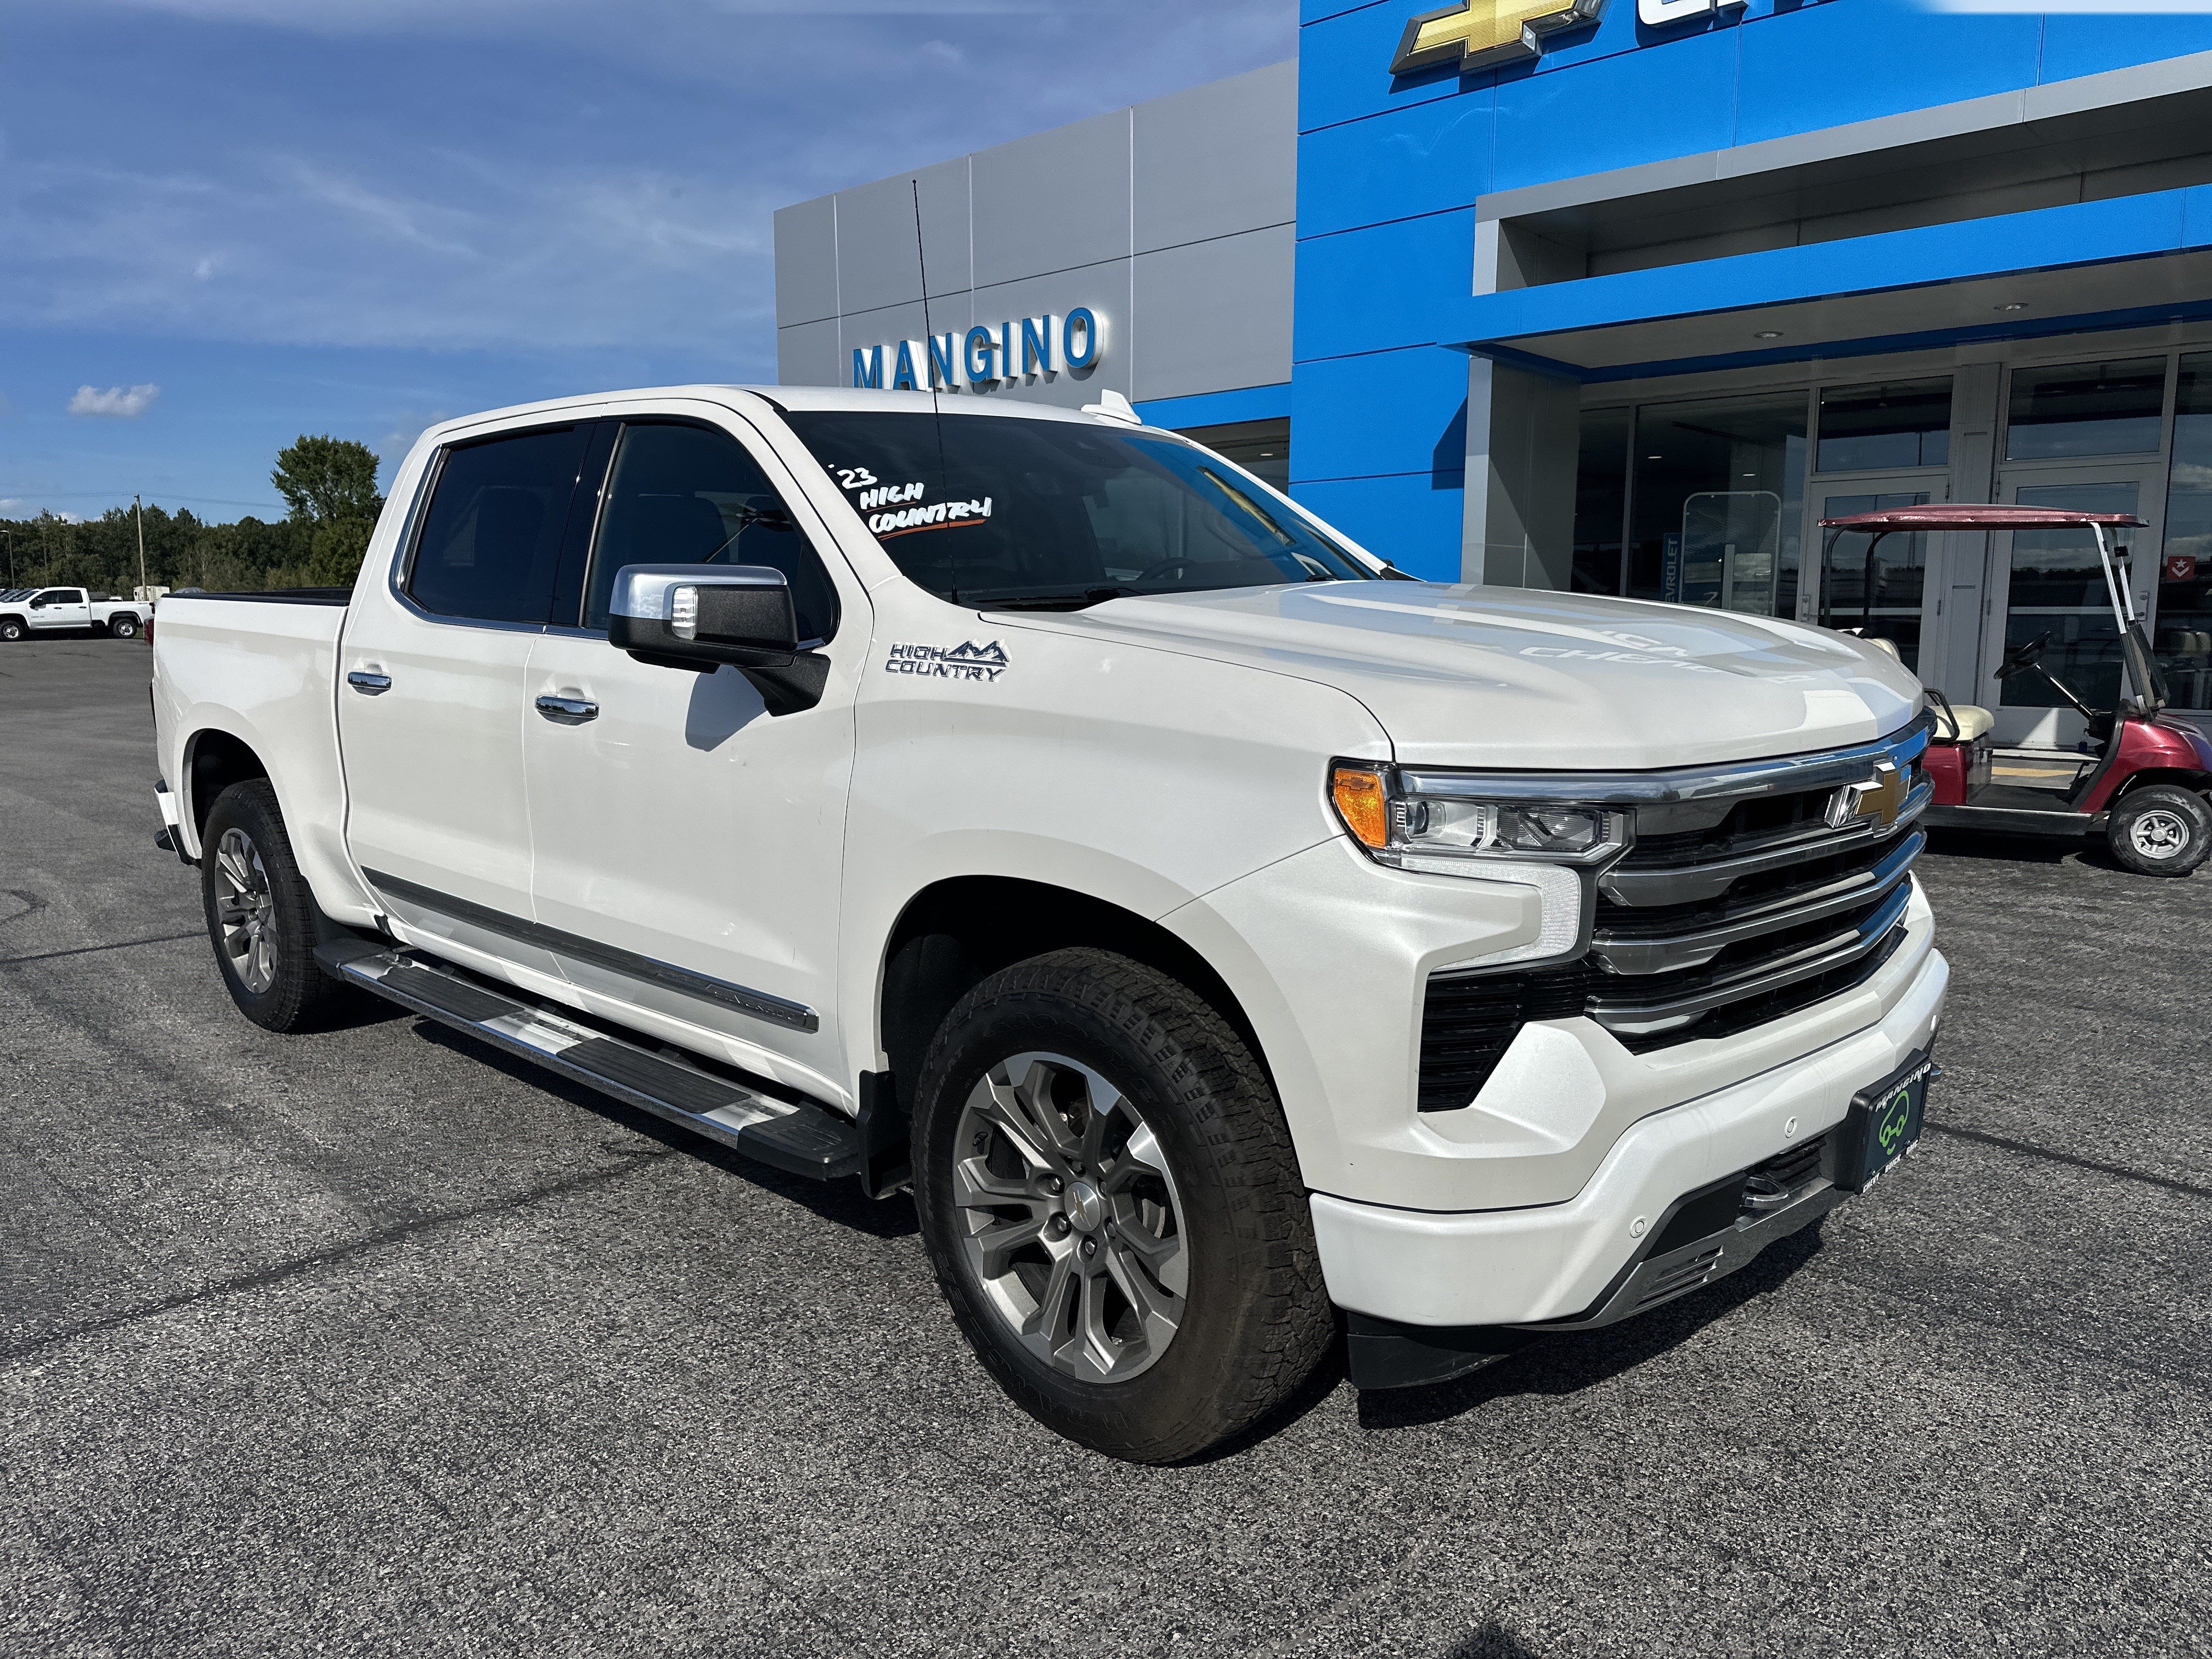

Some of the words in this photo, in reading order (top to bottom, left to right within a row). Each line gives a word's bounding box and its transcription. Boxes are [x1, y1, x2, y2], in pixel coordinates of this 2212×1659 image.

[853, 307, 1099, 391] MANGINO
[860, 482, 924, 509] HIGH
[869, 497, 992, 533] COUNTRY
[885, 658, 1006, 682] COUNTRY
[889, 643, 950, 661] HIGH
[1875, 1062, 1932, 1112] MANGINO
[1863, 1172, 1880, 1193] CHEVY
[1884, 1153, 1901, 1173] BUICK
